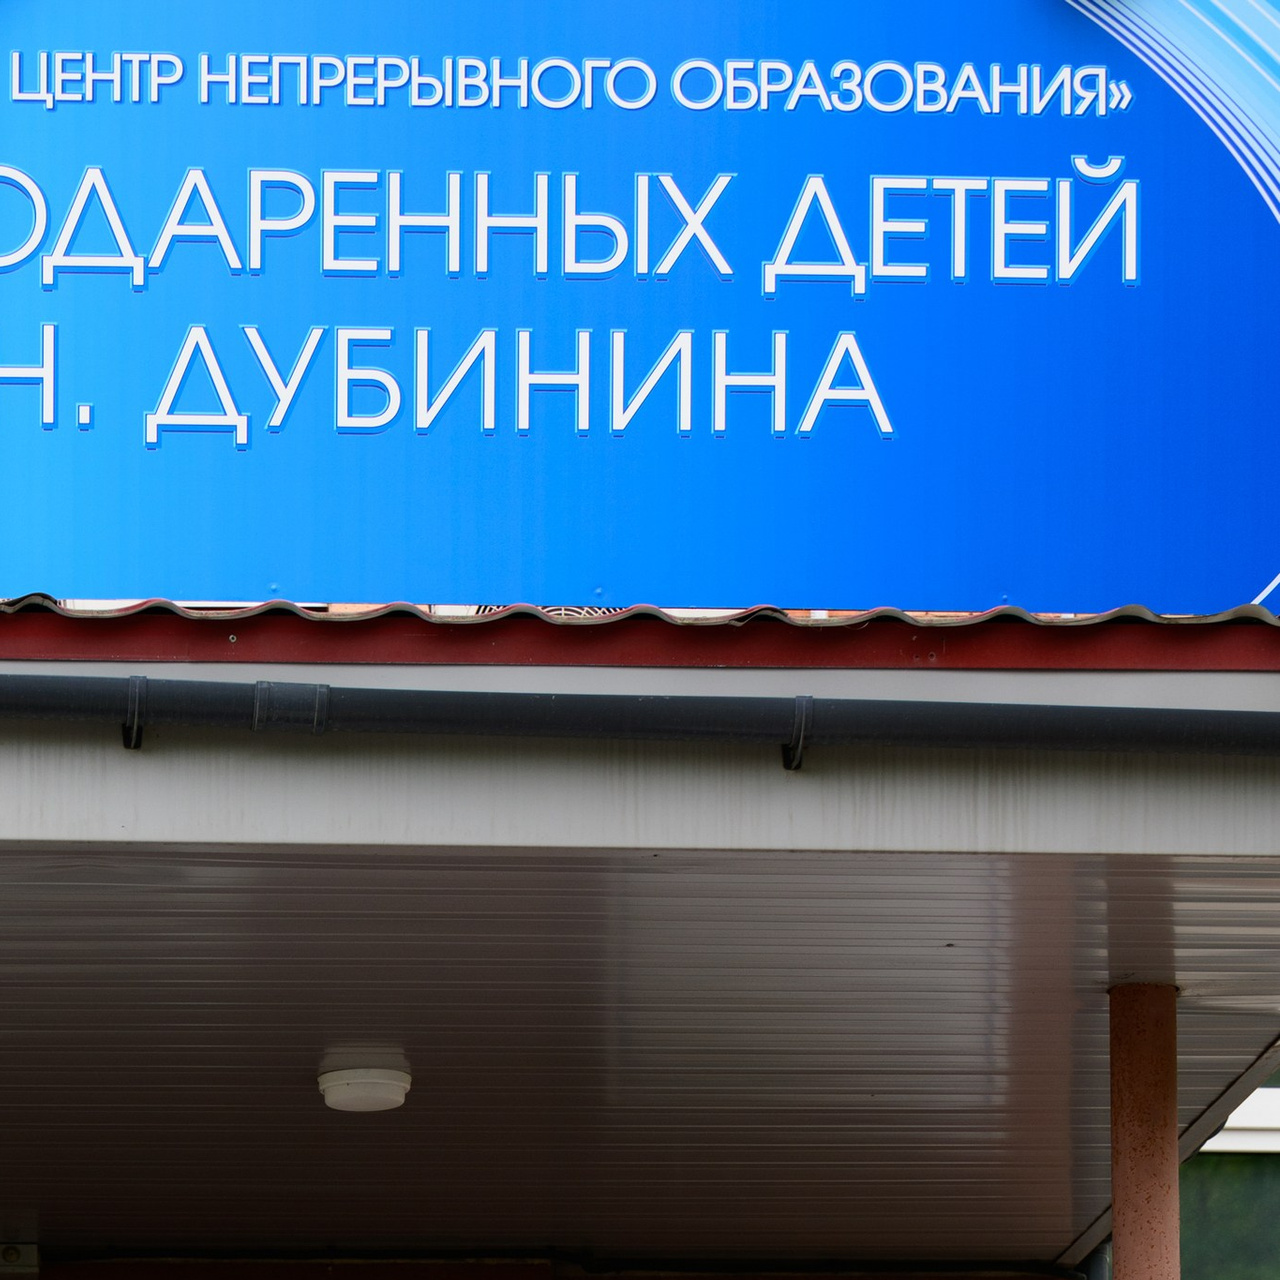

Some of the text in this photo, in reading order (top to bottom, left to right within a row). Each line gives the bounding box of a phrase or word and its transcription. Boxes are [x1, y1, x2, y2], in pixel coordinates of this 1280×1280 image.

[11, 51, 184, 110] ЦЕНТР
[200, 54, 658, 110] НЕПРЕРЫВНОГО
[671, 59, 1133, 116] ОБРАЗОВАНИЯ»
[763, 156, 1139, 298] ДЕТЕЙ
[144, 325, 894, 448] ДУБИНИНА
